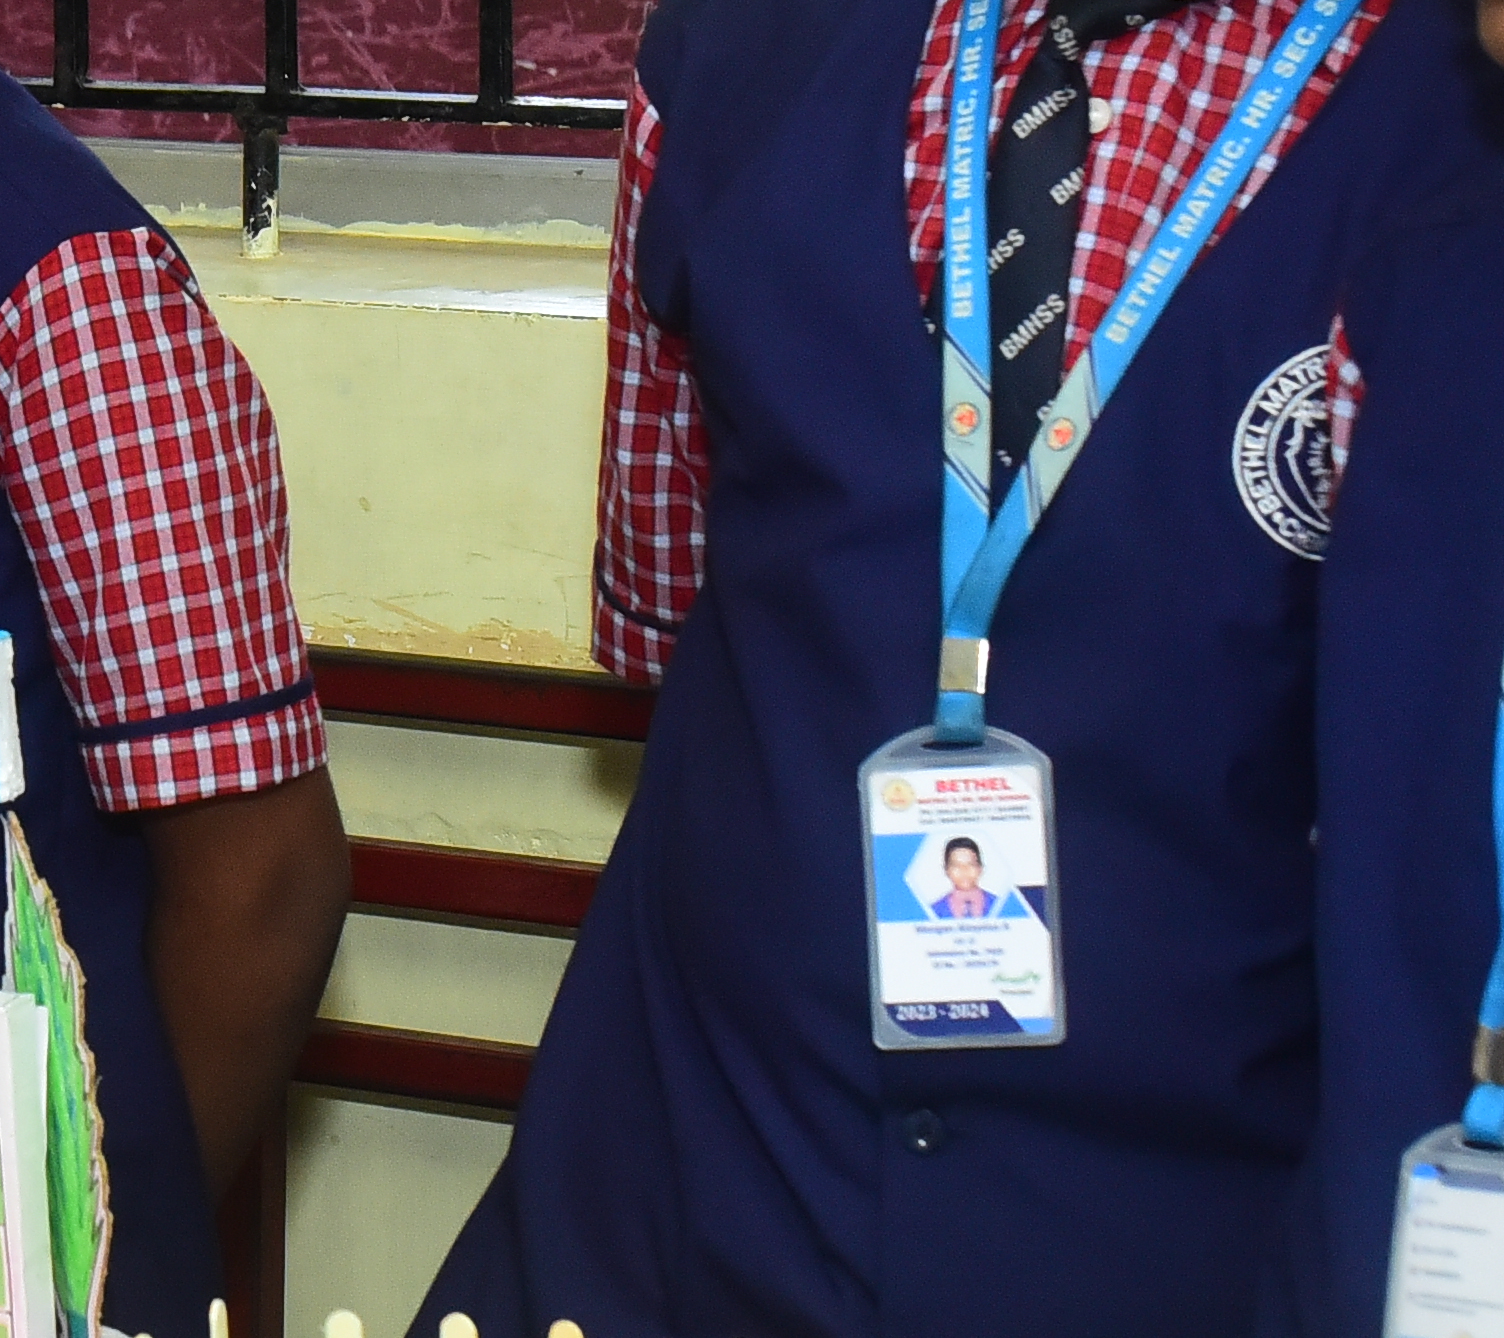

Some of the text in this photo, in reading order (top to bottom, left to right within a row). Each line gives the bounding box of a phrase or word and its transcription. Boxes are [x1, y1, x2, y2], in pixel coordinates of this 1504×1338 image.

[1105, 245, 1183, 344] BETHEL
[1241, 84, 1283, 130] HR.
[1273, 22, 1323, 79] SEC.
[951, 207, 974, 318] BETHEL
[999, 293, 1066, 361] BMHSS
[1257, 357, 1327, 416] MATR
[936, 777, 1012, 793] BETHEL
